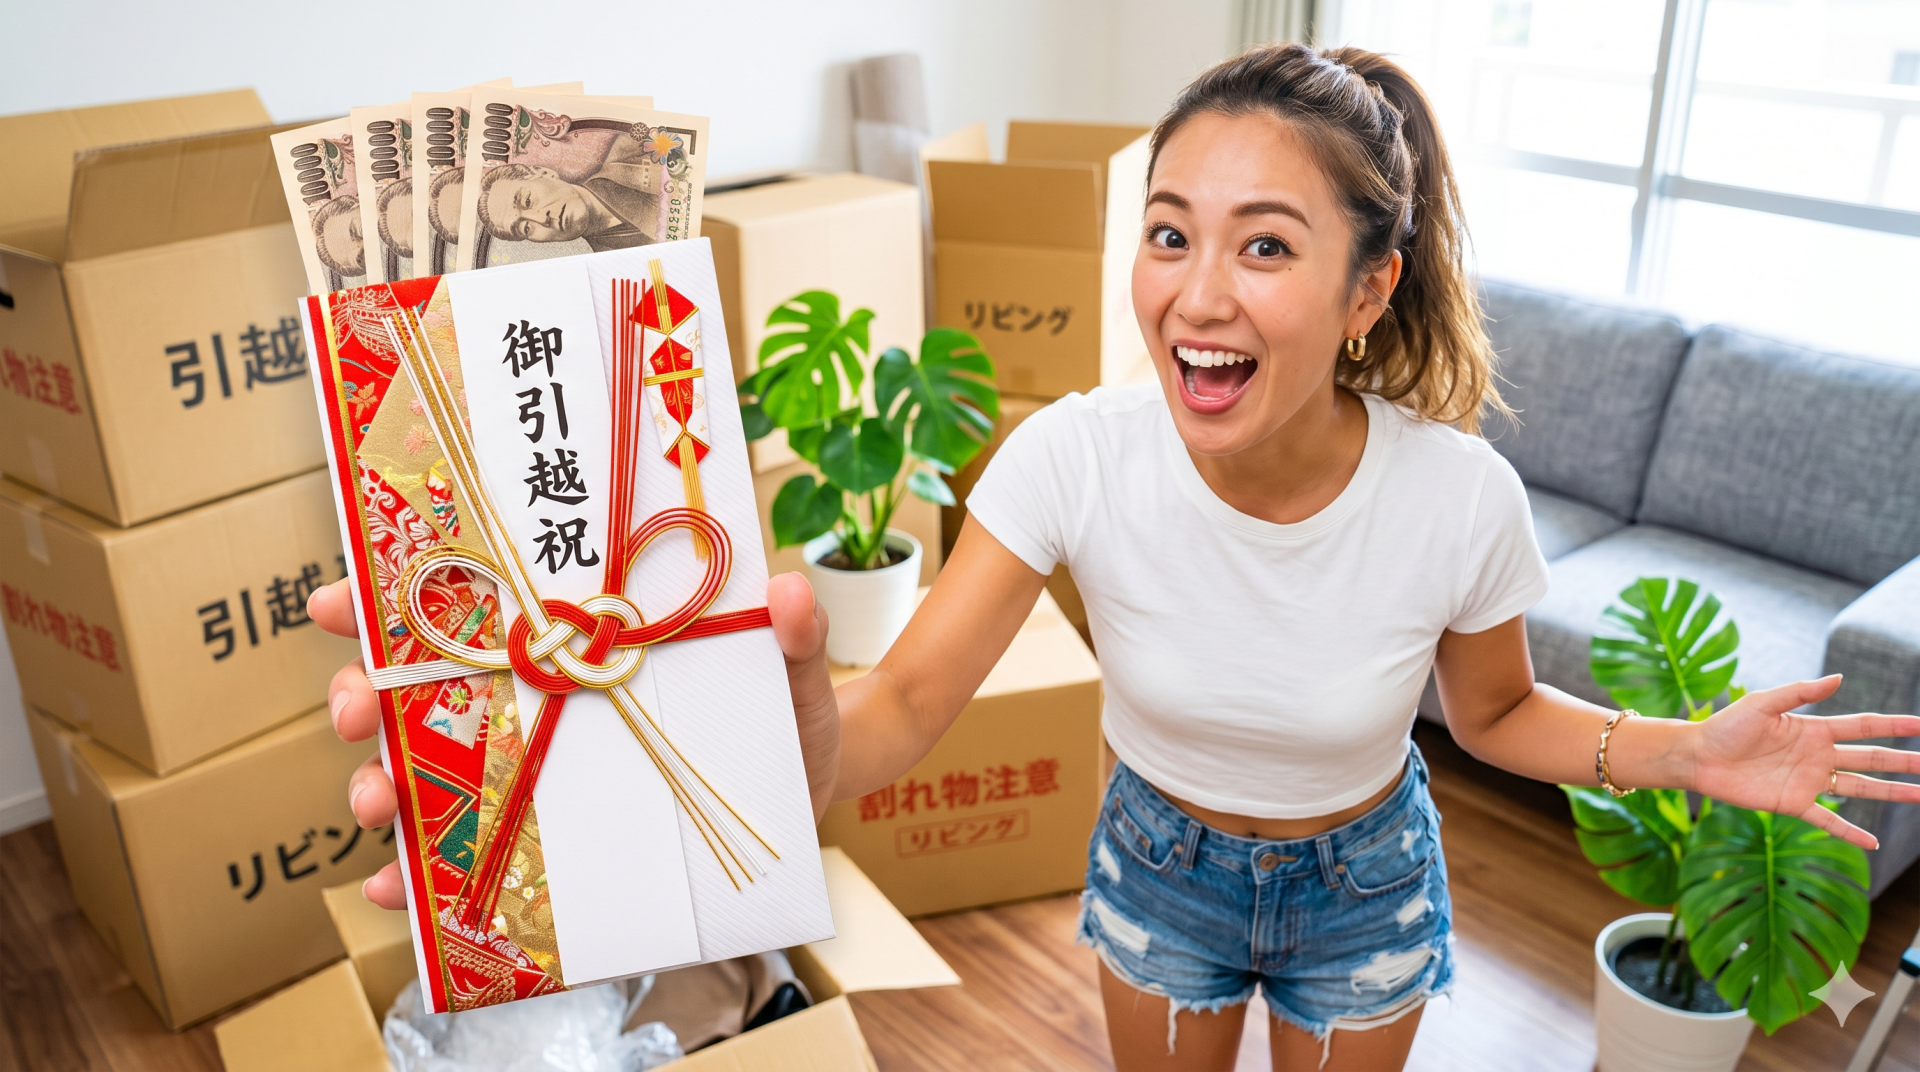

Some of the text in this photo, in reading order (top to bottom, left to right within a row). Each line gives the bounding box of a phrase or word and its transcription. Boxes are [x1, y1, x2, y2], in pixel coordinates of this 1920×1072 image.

[366, 120, 400, 183] 10000
[425, 107, 456, 169] 10000
[481, 102, 514, 164] 10000
[290, 142, 332, 206] 10000
[964, 301, 1076, 337] リビング
[501, 319, 600, 575] 御引越祝
[197, 554, 349, 662] 引越
[858, 757, 1061, 823] 割れ物注意
[911, 813, 1018, 853] リビング
